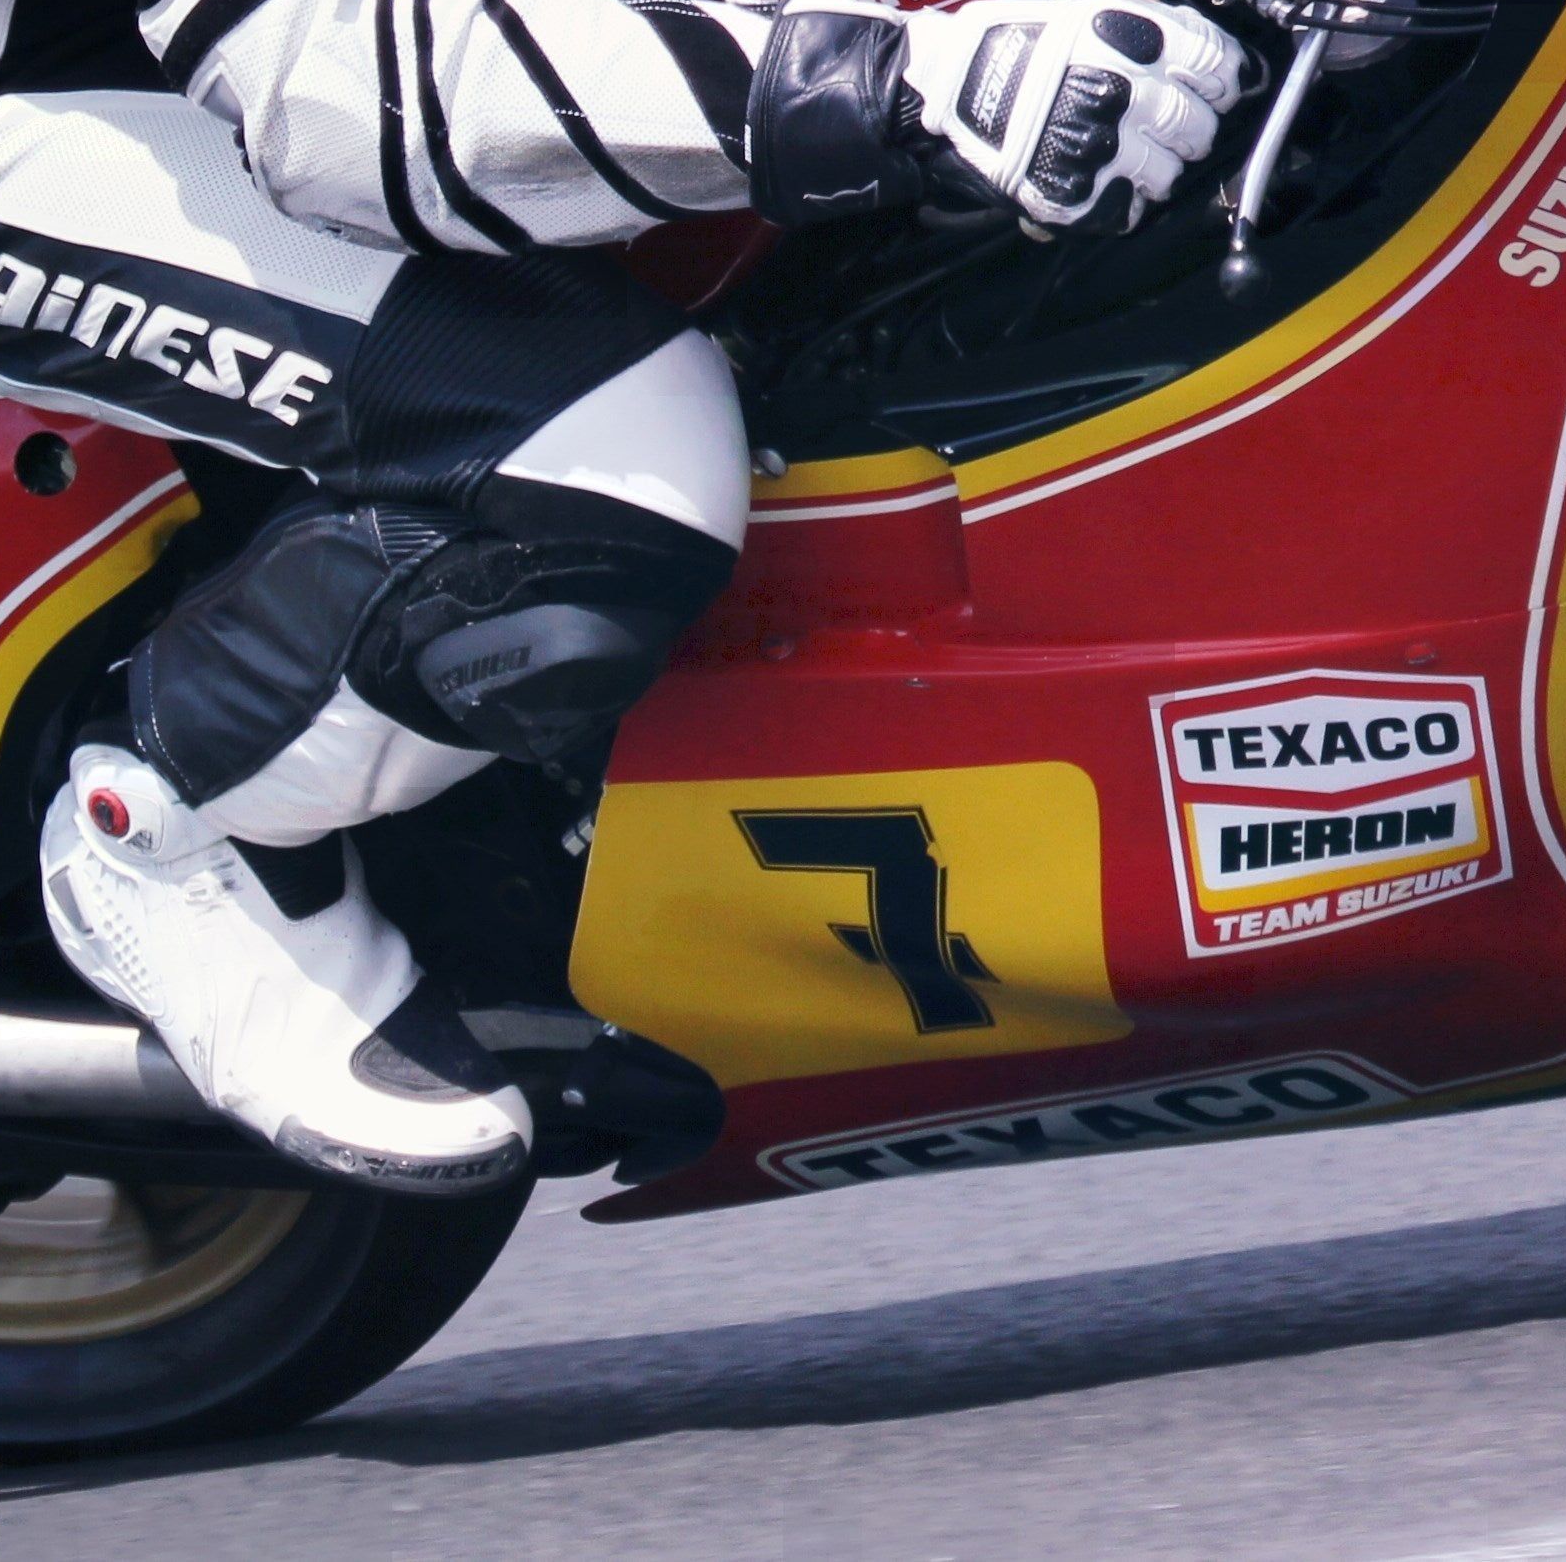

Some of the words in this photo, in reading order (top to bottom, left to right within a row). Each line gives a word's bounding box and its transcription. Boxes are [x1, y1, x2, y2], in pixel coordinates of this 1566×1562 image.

[1184, 712, 1460, 772] TEXACO
[1219, 802, 1456, 874] HERON
[732, 804, 999, 1034] 7
[1215, 898, 1327, 943] TEAM
[1336, 860, 1481, 917] SUZUKI
[804, 1067, 1370, 1183] TEXACO
